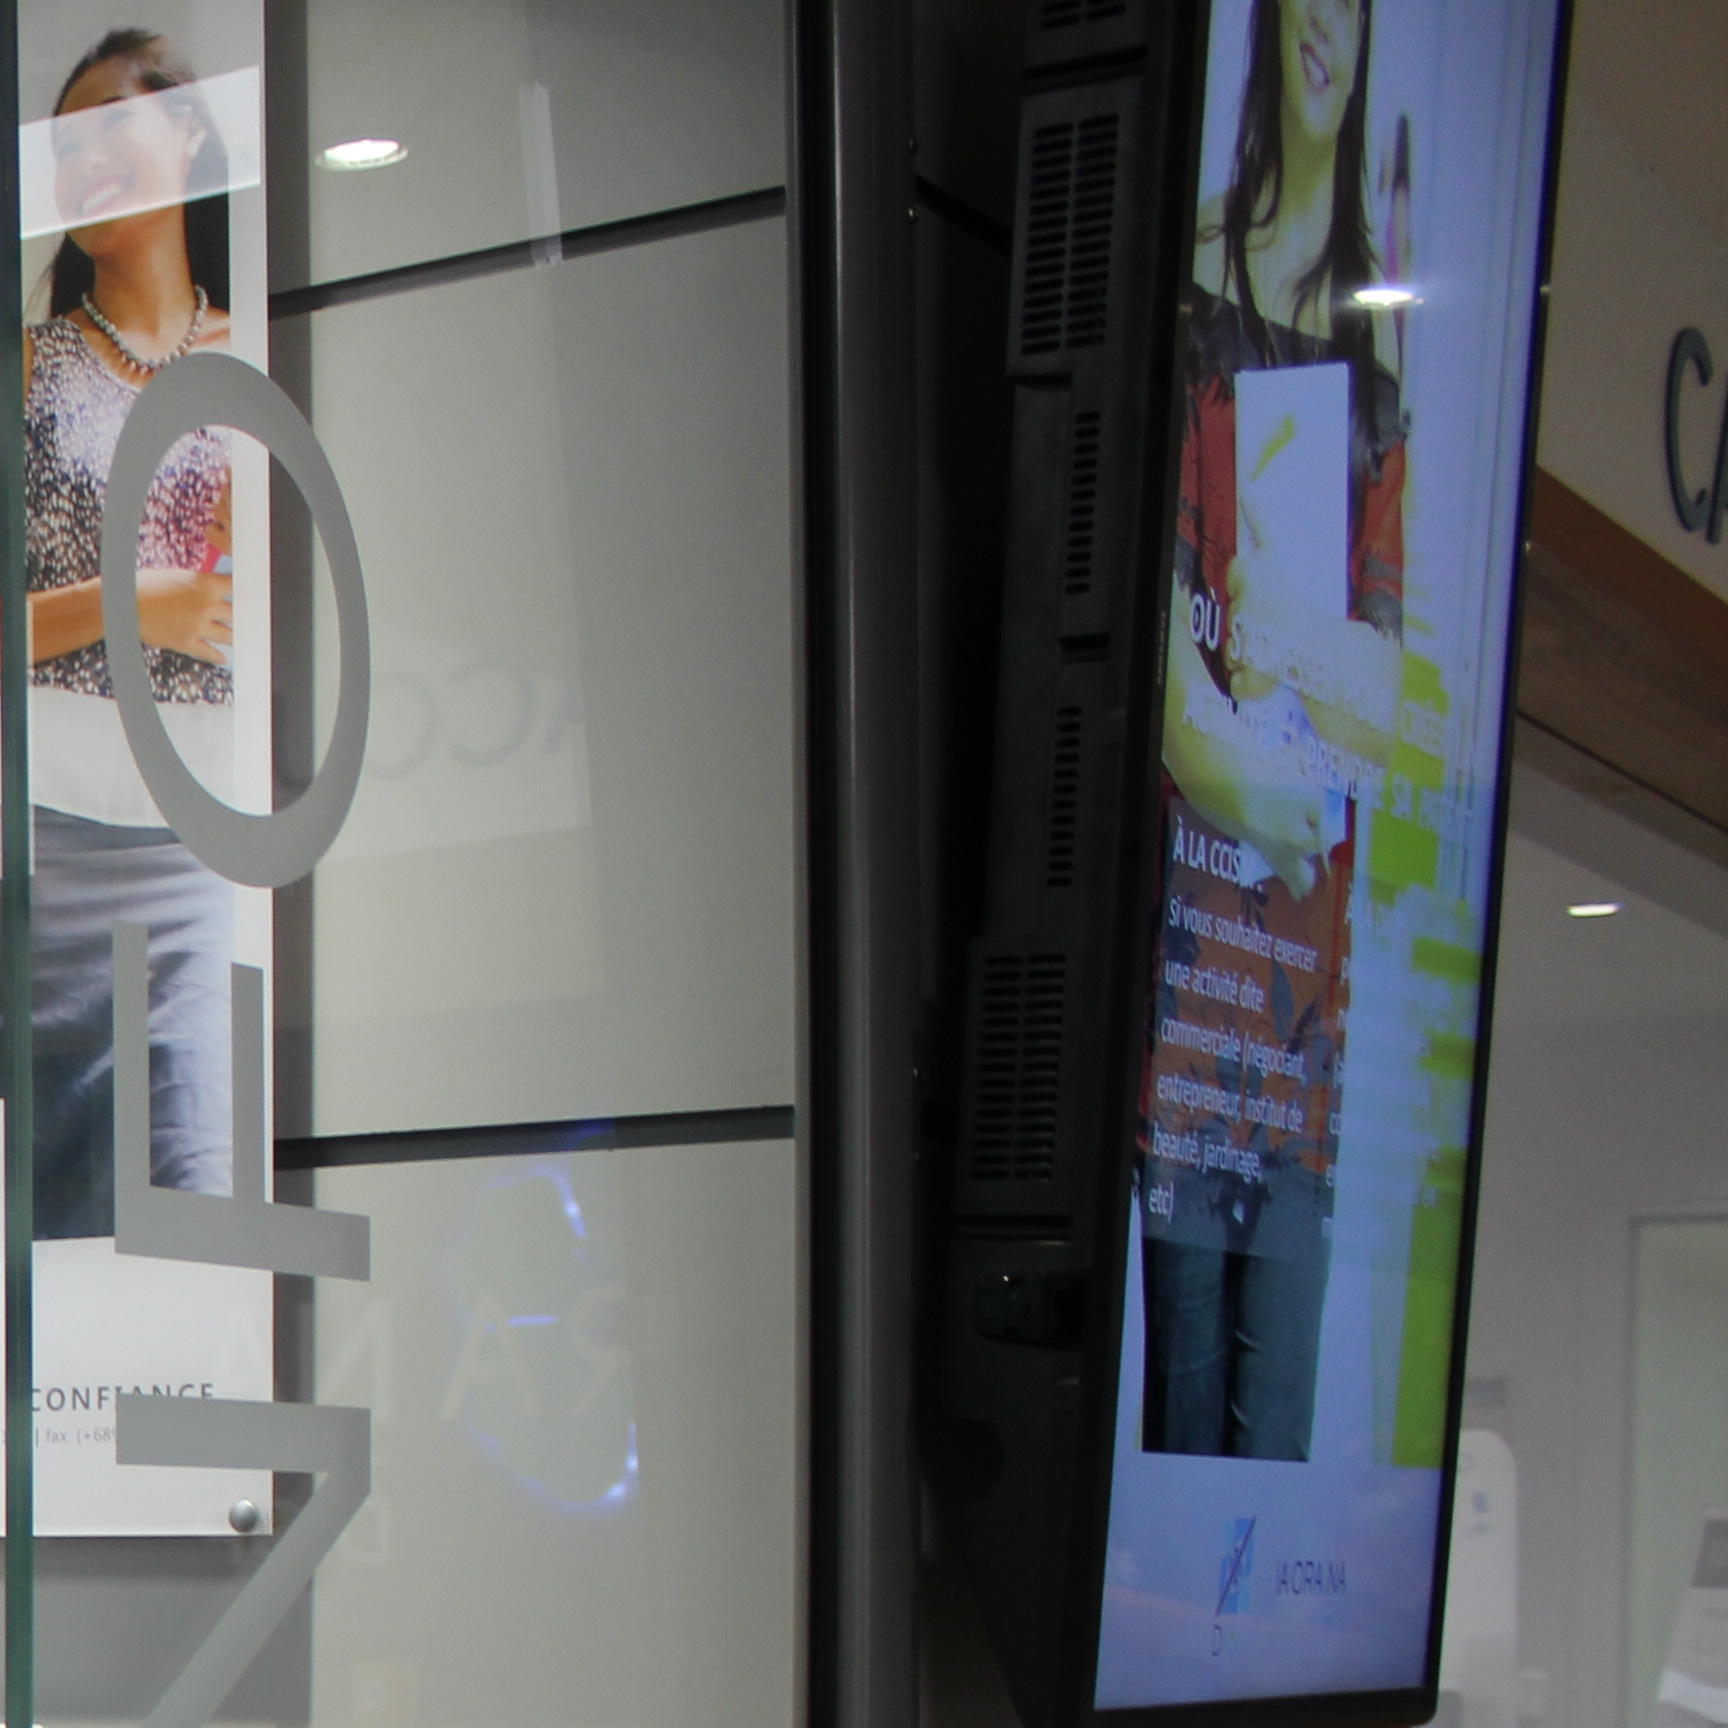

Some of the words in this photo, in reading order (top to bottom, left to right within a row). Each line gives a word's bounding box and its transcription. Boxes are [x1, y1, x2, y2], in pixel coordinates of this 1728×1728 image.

[1169, 895, 1181, 928] si
[1183, 905, 1214, 938] vous
[1215, 915, 1273, 959] souhaitez
[1274, 936, 1318, 974] exercer
[1164, 959, 1191, 990] une
[1192, 966, 1238, 1004] activité
[1239, 972, 1265, 1013] dite
[1160, 1017, 1241, 1062] commerciale
[1156, 1072, 1241, 1125] entrepreneur,
[1245, 1090, 1286, 1131] institut
[1287, 1107, 1304, 1134] de
[1152, 1119, 1200, 1170] beauté,
[1201, 1135, 1263, 1185] jardinage,
